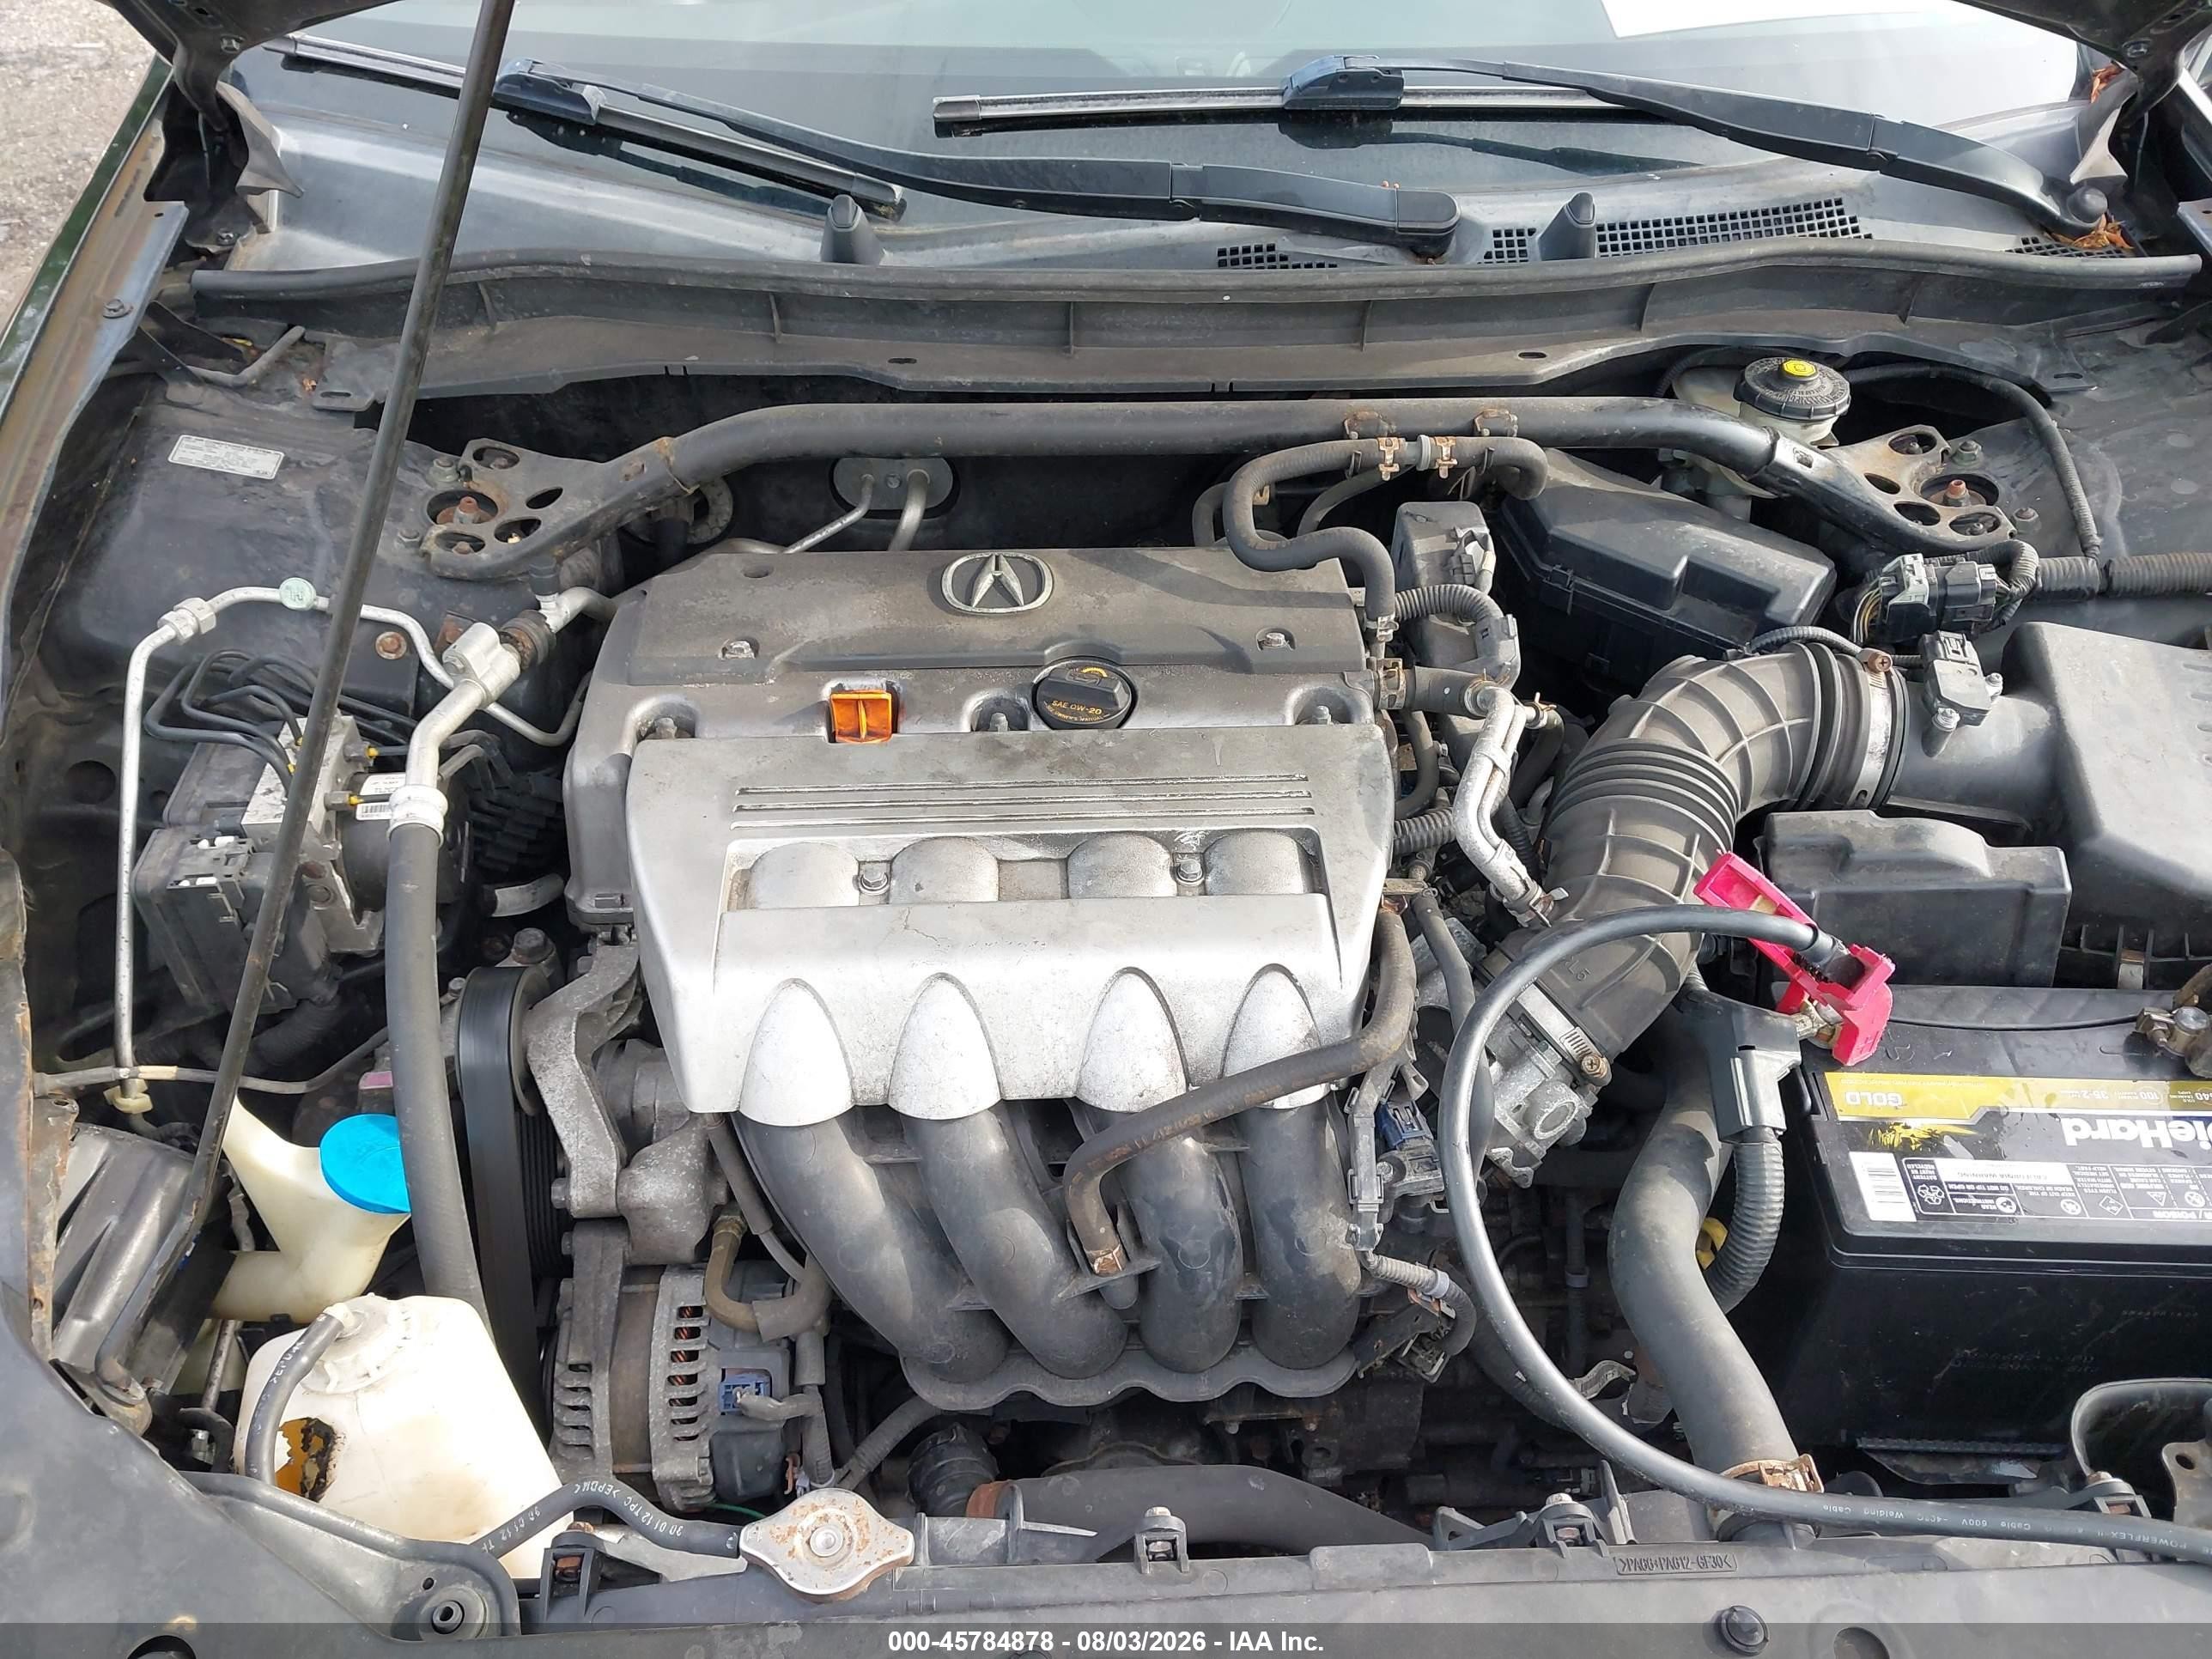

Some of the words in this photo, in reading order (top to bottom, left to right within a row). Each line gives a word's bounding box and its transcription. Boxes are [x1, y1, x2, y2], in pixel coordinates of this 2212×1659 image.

[1052, 700, 1068, 708] SAE
[1070, 704, 1102, 714] 0W-20
[1844, 1091, 1903, 1107] GOLD
[2139, 1091, 2159, 1100] 100
[623, 1497, 642, 1516] TPC
[1823, 1504, 1852, 1515] Cable
[641, 1512, 653, 1526] 12
[1863, 1508, 1904, 1520] Welding
[653, 1519, 667, 1533] 01
[1962, 1518, 1987, 1528] 600V
[2001, 1521, 2031, 1532] Cable
[669, 1524, 684, 1537] 30
[2111, 1531, 2186, 1550] POWERFLEX
